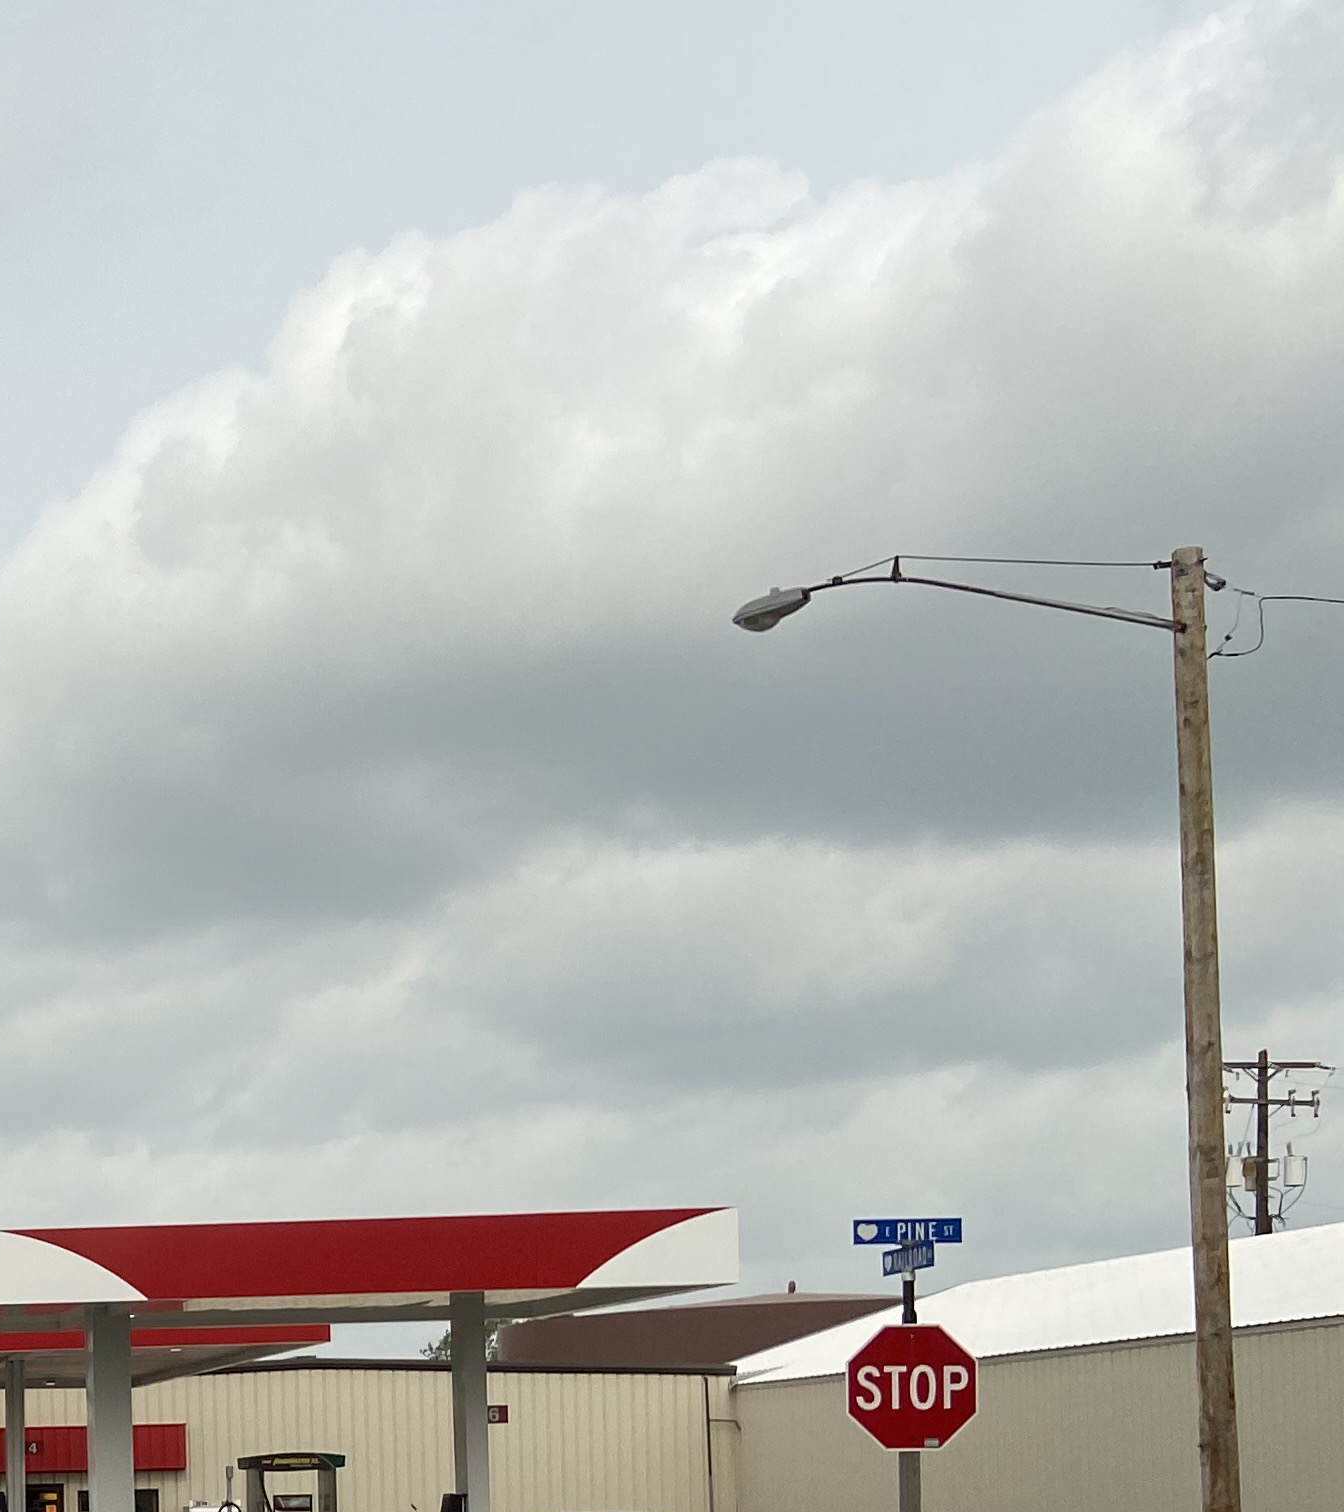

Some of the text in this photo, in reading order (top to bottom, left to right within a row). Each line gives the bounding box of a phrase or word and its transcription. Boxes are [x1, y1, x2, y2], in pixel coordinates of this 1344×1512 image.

[885, 1221, 954, 1241] E PINE ST
[856, 1364, 969, 1411] STOP
[488, 1407, 500, 1422] 6
[28, 1442, 38, 1454] 4
